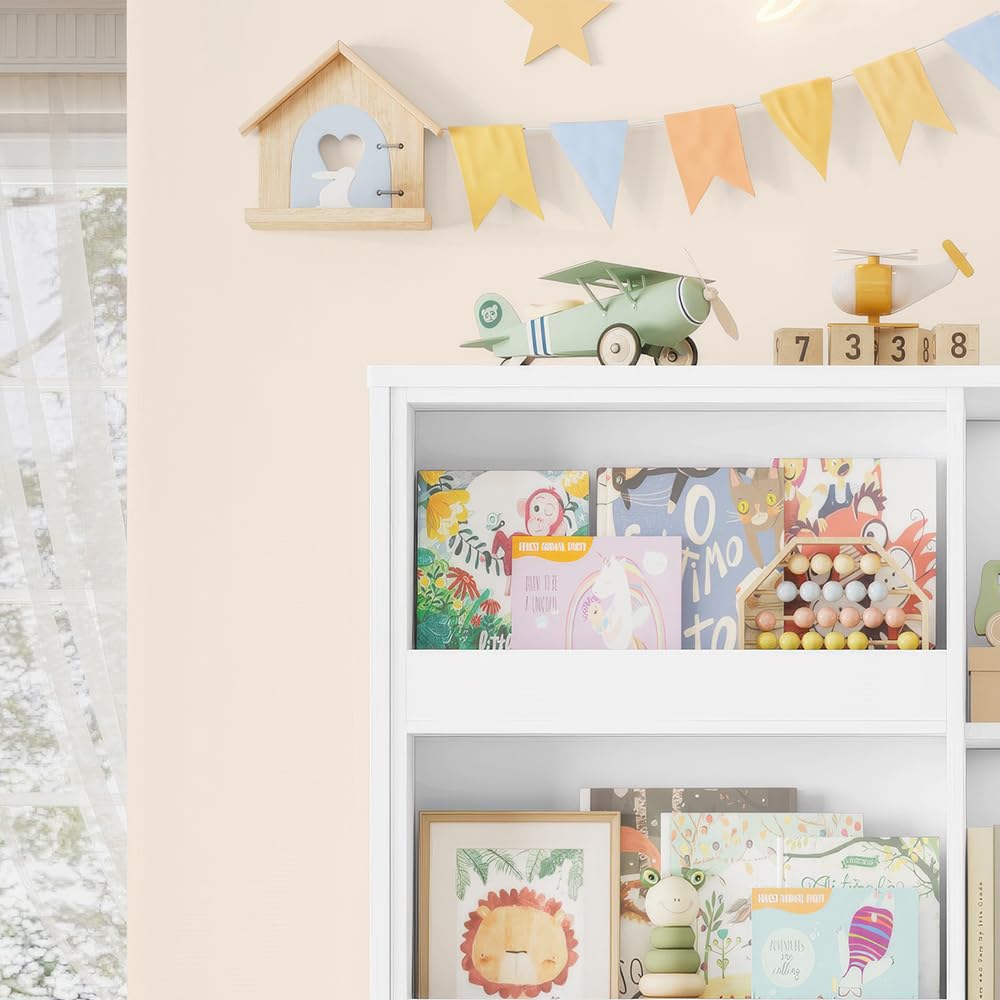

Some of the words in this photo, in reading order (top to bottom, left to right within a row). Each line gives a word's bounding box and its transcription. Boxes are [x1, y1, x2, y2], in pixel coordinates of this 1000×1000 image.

[795, 336, 810, 362] 7
[845, 333, 861, 360] 3
[891, 335, 906, 362] 3
[951, 332, 967, 359] 8
